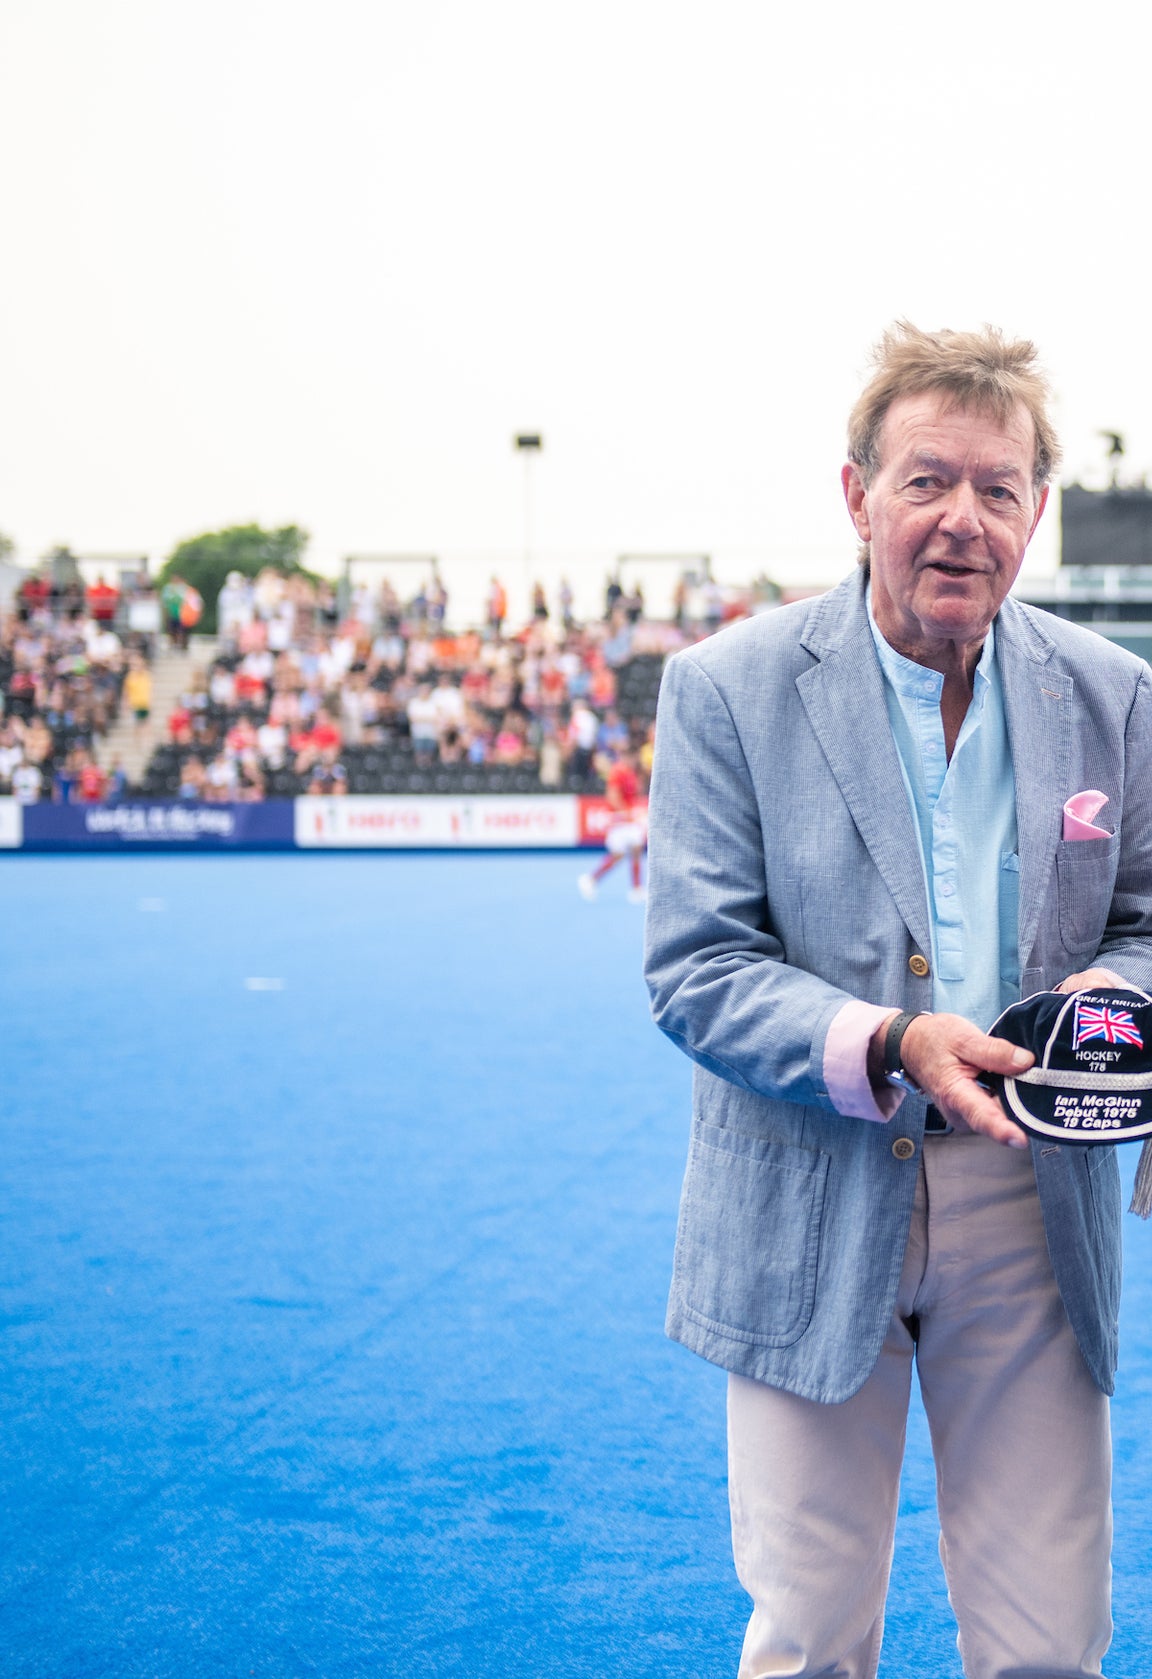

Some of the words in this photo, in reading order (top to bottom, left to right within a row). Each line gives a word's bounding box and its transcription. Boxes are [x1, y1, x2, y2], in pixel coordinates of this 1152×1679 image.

[1076, 995, 1110, 1004] GREAT
[1112, 999, 1151, 1008] BRITAIN
[1075, 1051, 1122, 1062] HOCKEY
[1089, 1062, 1107, 1072] 178
[1055, 1095, 1079, 1106] Ian
[1081, 1095, 1142, 1108] McGinn
[1053, 1106, 1099, 1118] Debut
[1063, 1117, 1079, 1128] 19
[1081, 1117, 1121, 1130] Caps
